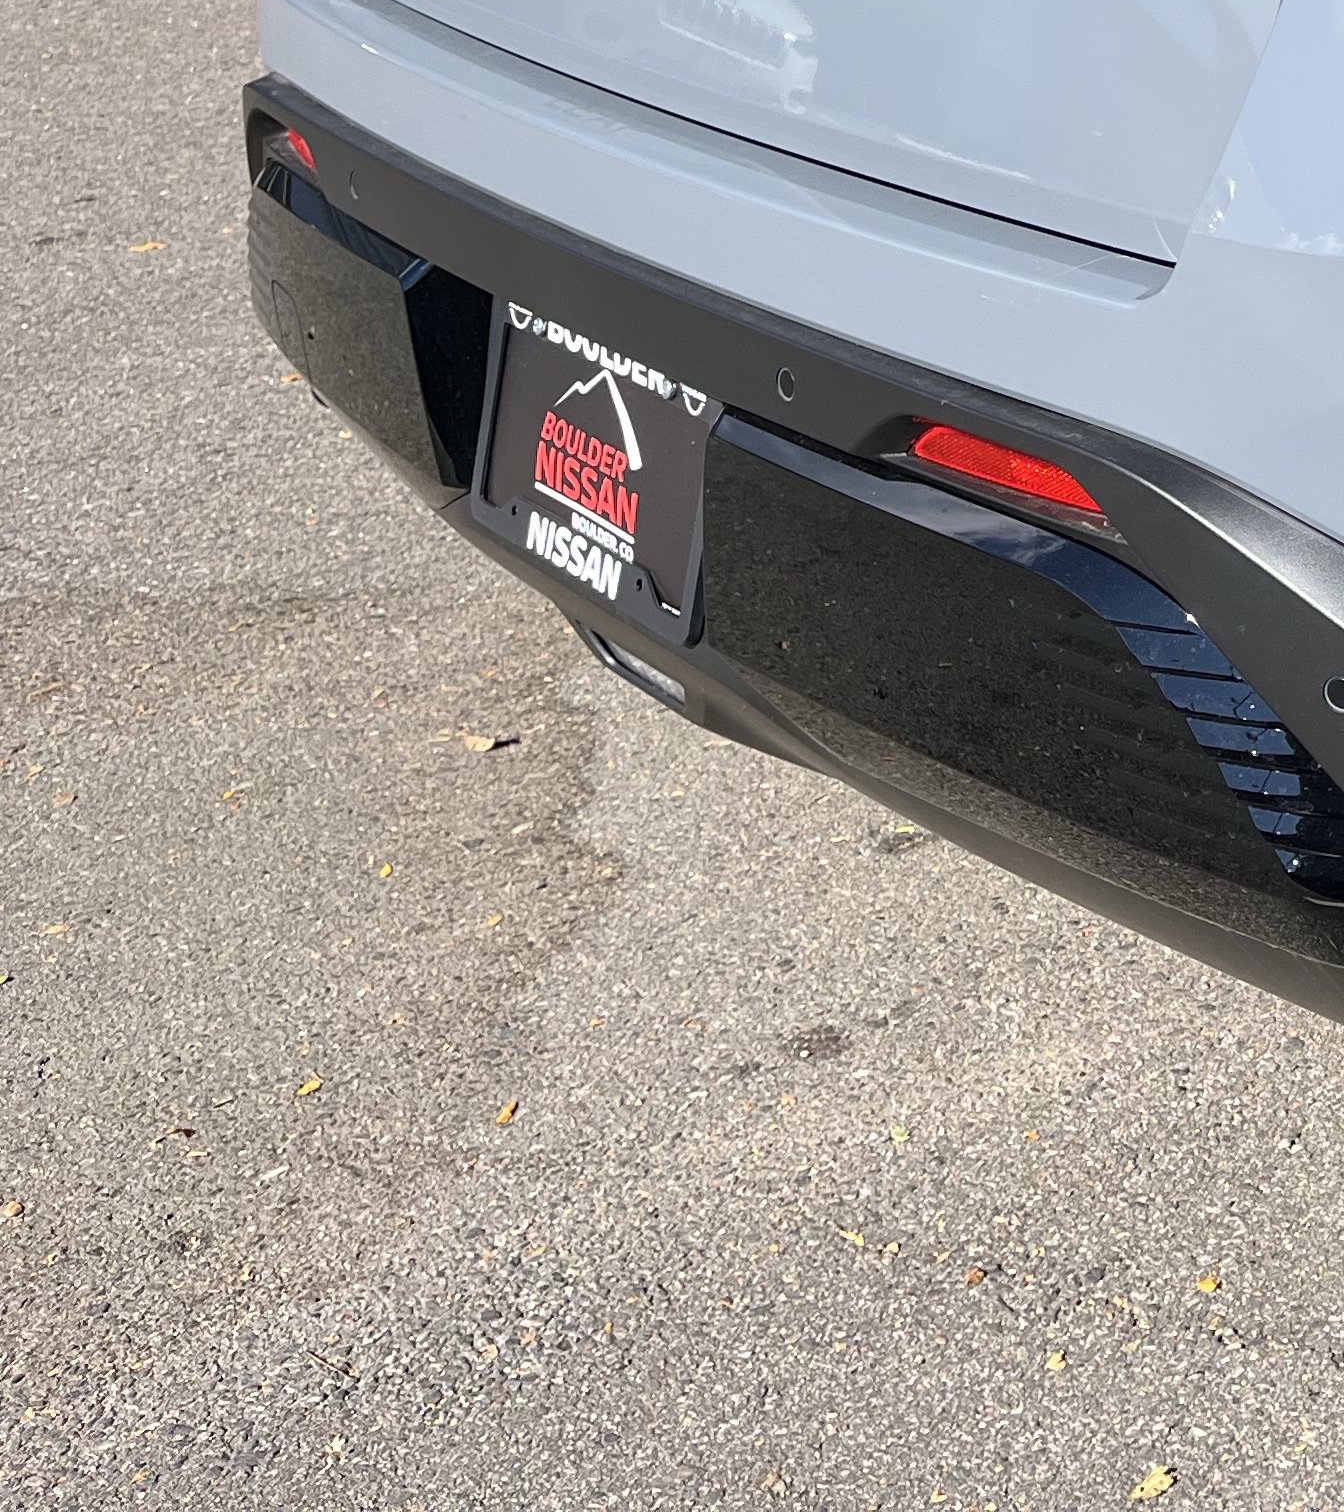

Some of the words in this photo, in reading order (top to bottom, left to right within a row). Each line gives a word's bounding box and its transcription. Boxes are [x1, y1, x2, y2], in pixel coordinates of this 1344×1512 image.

[534, 440, 639, 535] NISSAN
[540, 410, 629, 483] BOULDER
[525, 510, 623, 601] NISSAN
